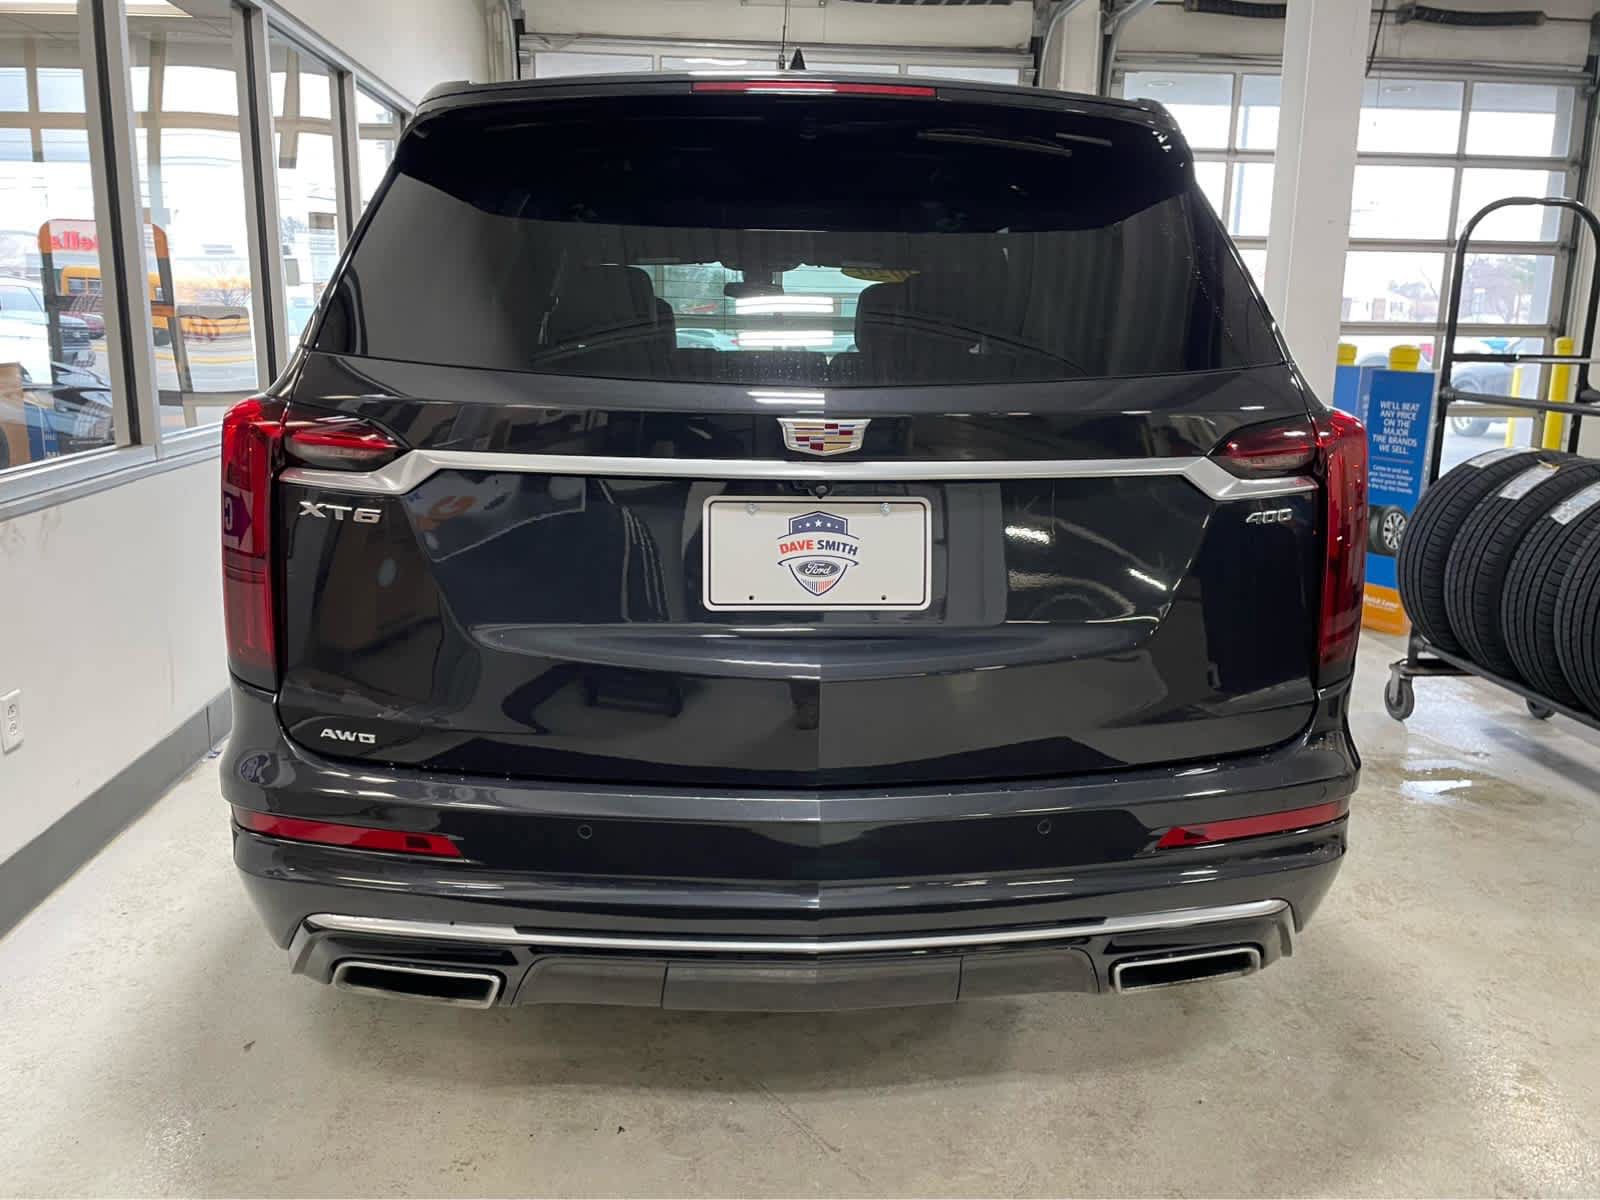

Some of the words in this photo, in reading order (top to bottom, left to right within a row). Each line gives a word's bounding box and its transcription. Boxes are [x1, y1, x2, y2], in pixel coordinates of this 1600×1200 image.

[1380, 410, 1395, 418] ANY
[1397, 411, 1417, 421] PRICE
[1383, 418, 1395, 427] ON
[1397, 419, 1410, 428] THE
[1383, 427, 1409, 436] MAJOR
[1373, 434, 1386, 443] TIRE
[1388, 436, 1417, 447] BRANDS
[1379, 445, 1390, 453] WE
[298, 501, 382, 524] XT6
[1245, 508, 1293, 525] 400
[779, 539, 814, 555] DAVE
[817, 539, 858, 556] SMITH
[804, 560, 832, 575] Ford
[319, 728, 376, 744] AWD
